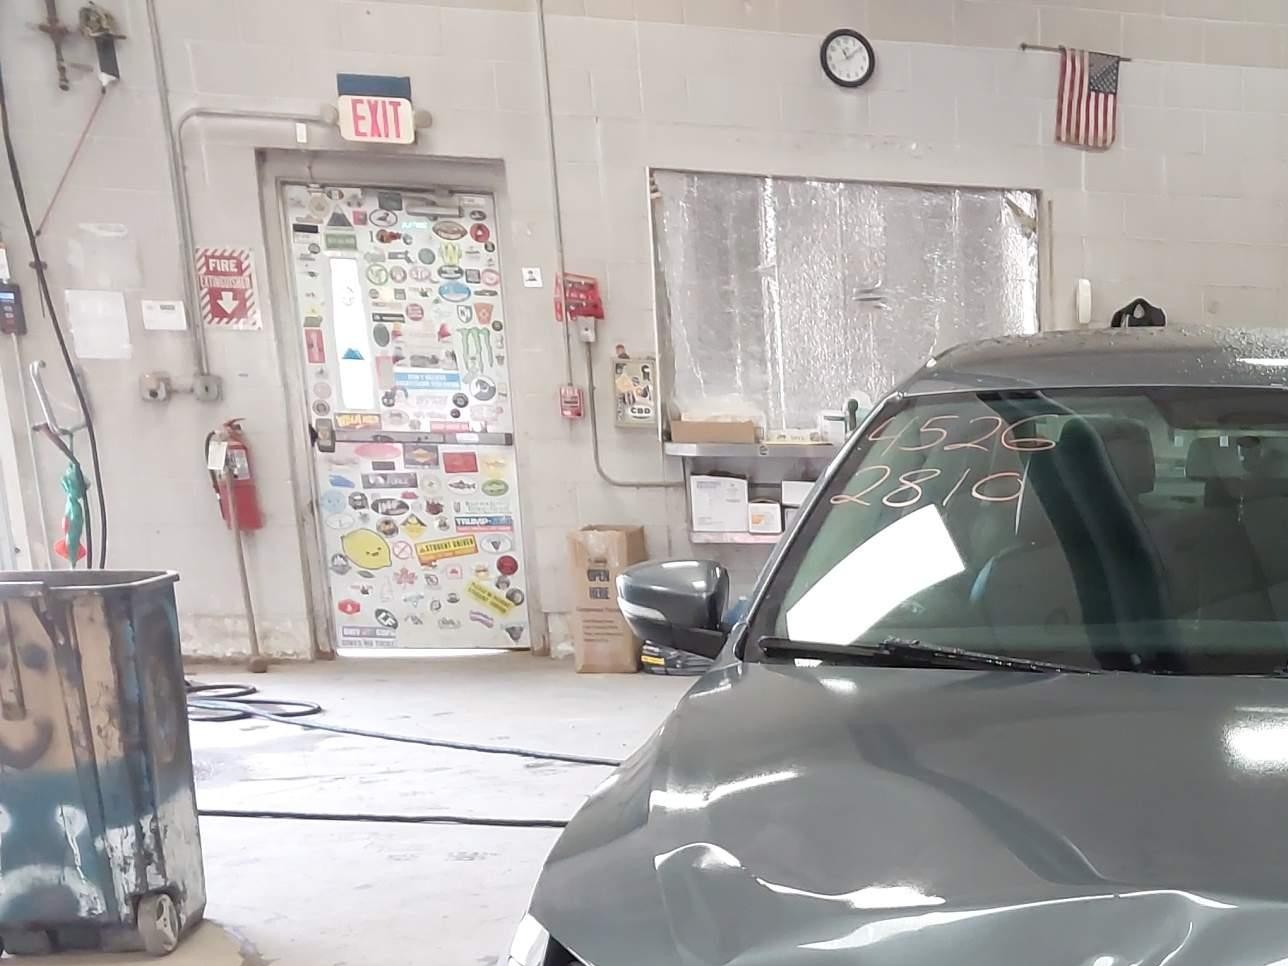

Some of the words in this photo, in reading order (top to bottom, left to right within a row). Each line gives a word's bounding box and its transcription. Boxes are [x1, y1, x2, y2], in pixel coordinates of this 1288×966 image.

[351, 98, 401, 139] EXIT
[208, 258, 239, 273] FIRE
[868, 414, 1057, 457] 4526
[587, 569, 610, 582] OPEN
